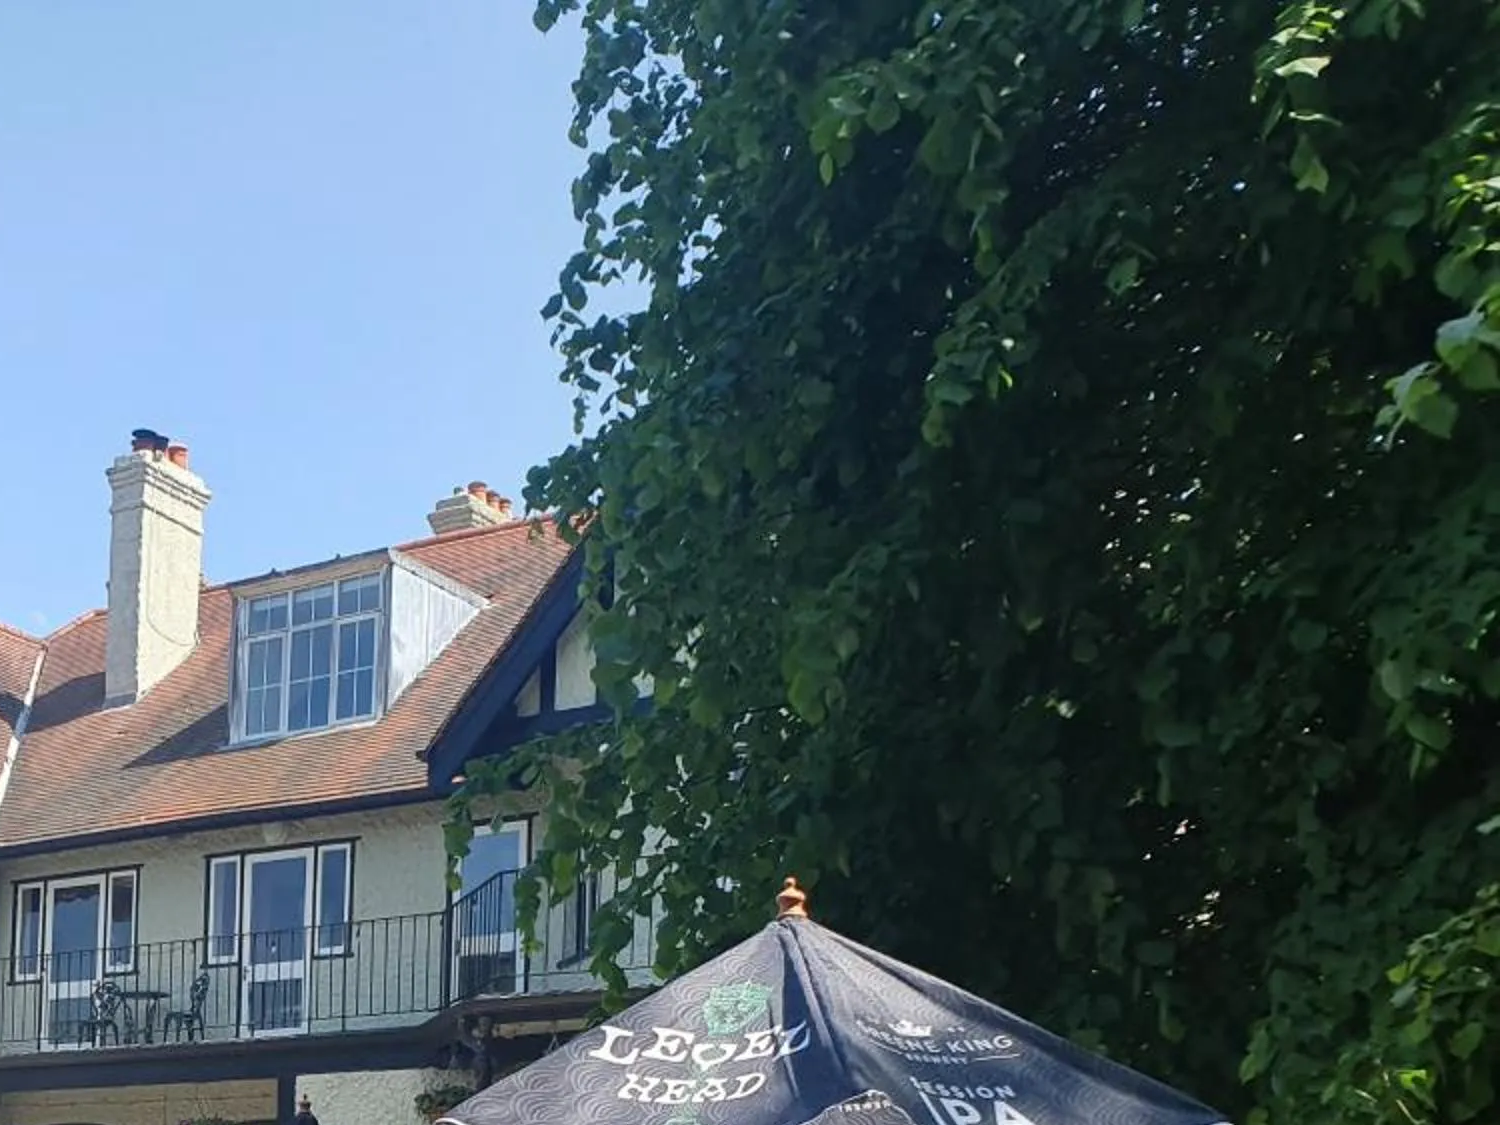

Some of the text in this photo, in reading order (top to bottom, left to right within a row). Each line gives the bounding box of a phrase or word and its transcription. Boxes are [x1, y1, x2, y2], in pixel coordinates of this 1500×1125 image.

[589, 1020, 811, 1071] LEVEL
[946, 1034, 1014, 1054] KING
[617, 1073, 766, 1104] HEAD
[909, 1076, 1017, 1099] SESSION
